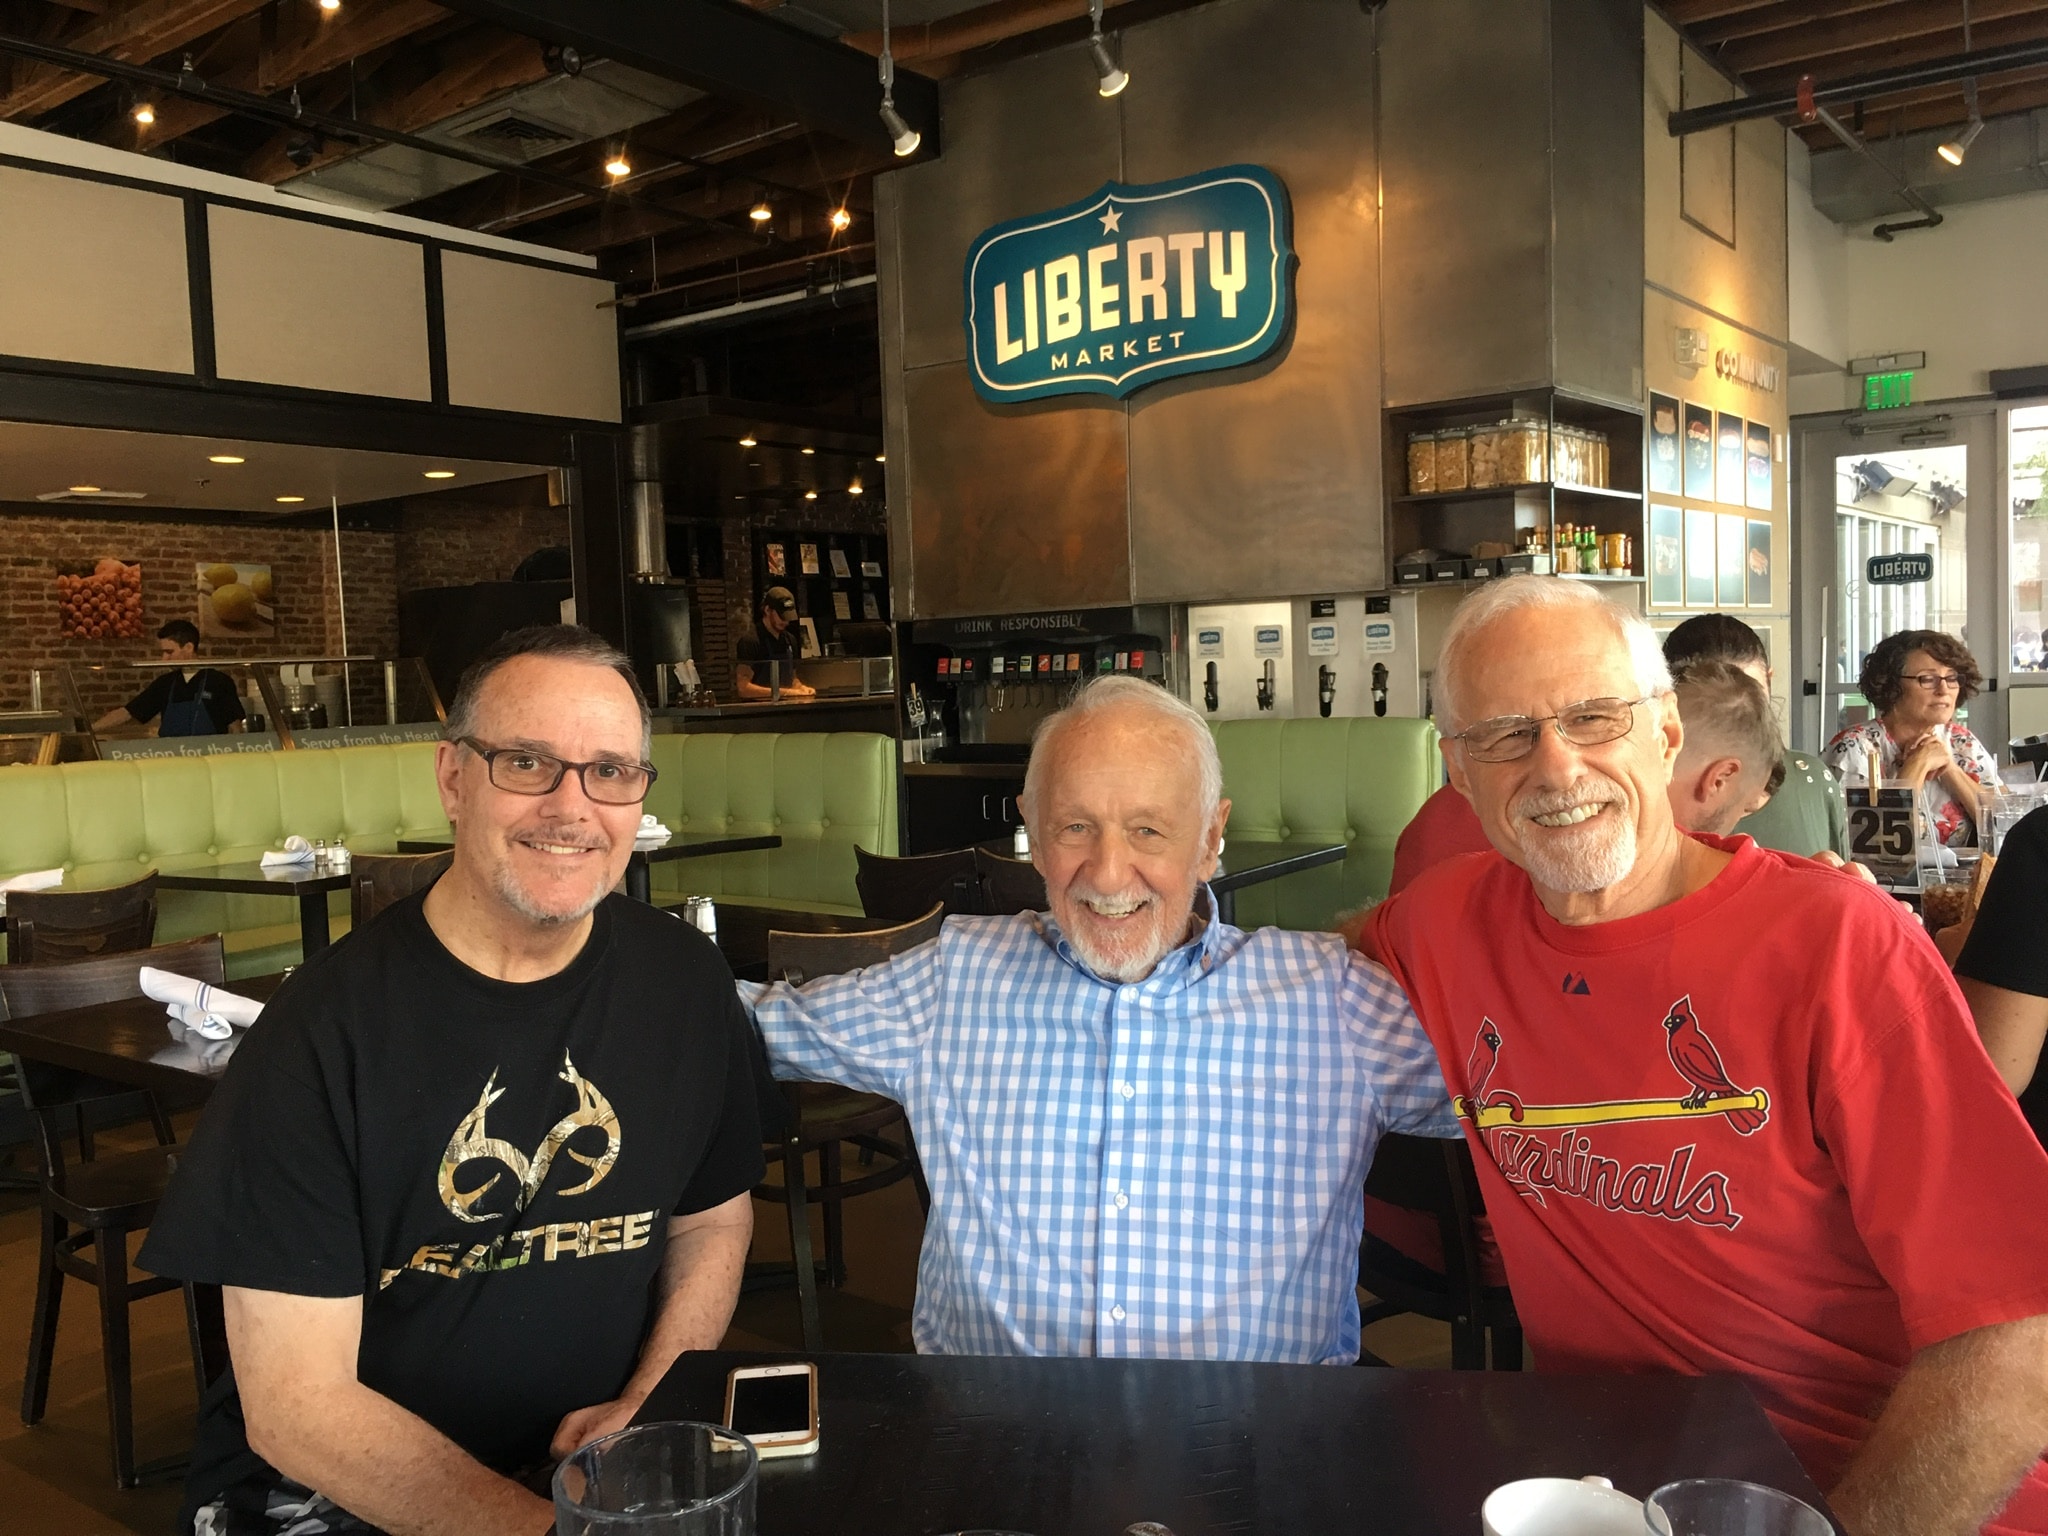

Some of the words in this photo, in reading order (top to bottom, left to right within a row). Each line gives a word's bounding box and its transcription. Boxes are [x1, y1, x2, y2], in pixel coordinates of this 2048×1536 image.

[993, 230, 1247, 366] LIBERTY
[1051, 331, 1185, 371] MARKET
[1720, 349, 1781, 393] COMMUNITY
[1866, 371, 1914, 411] EXIT
[1873, 561, 1927, 579] LIBERTY
[954, 620, 993, 634] DRINK
[1000, 614, 1083, 631] RESPONSIBLY
[908, 699, 923, 716] 39
[301, 738, 341, 750] Serve
[343, 734, 377, 747] from
[379, 732, 401, 745] the
[404, 730, 440, 743] Heart
[1850, 809, 1913, 856] 25
